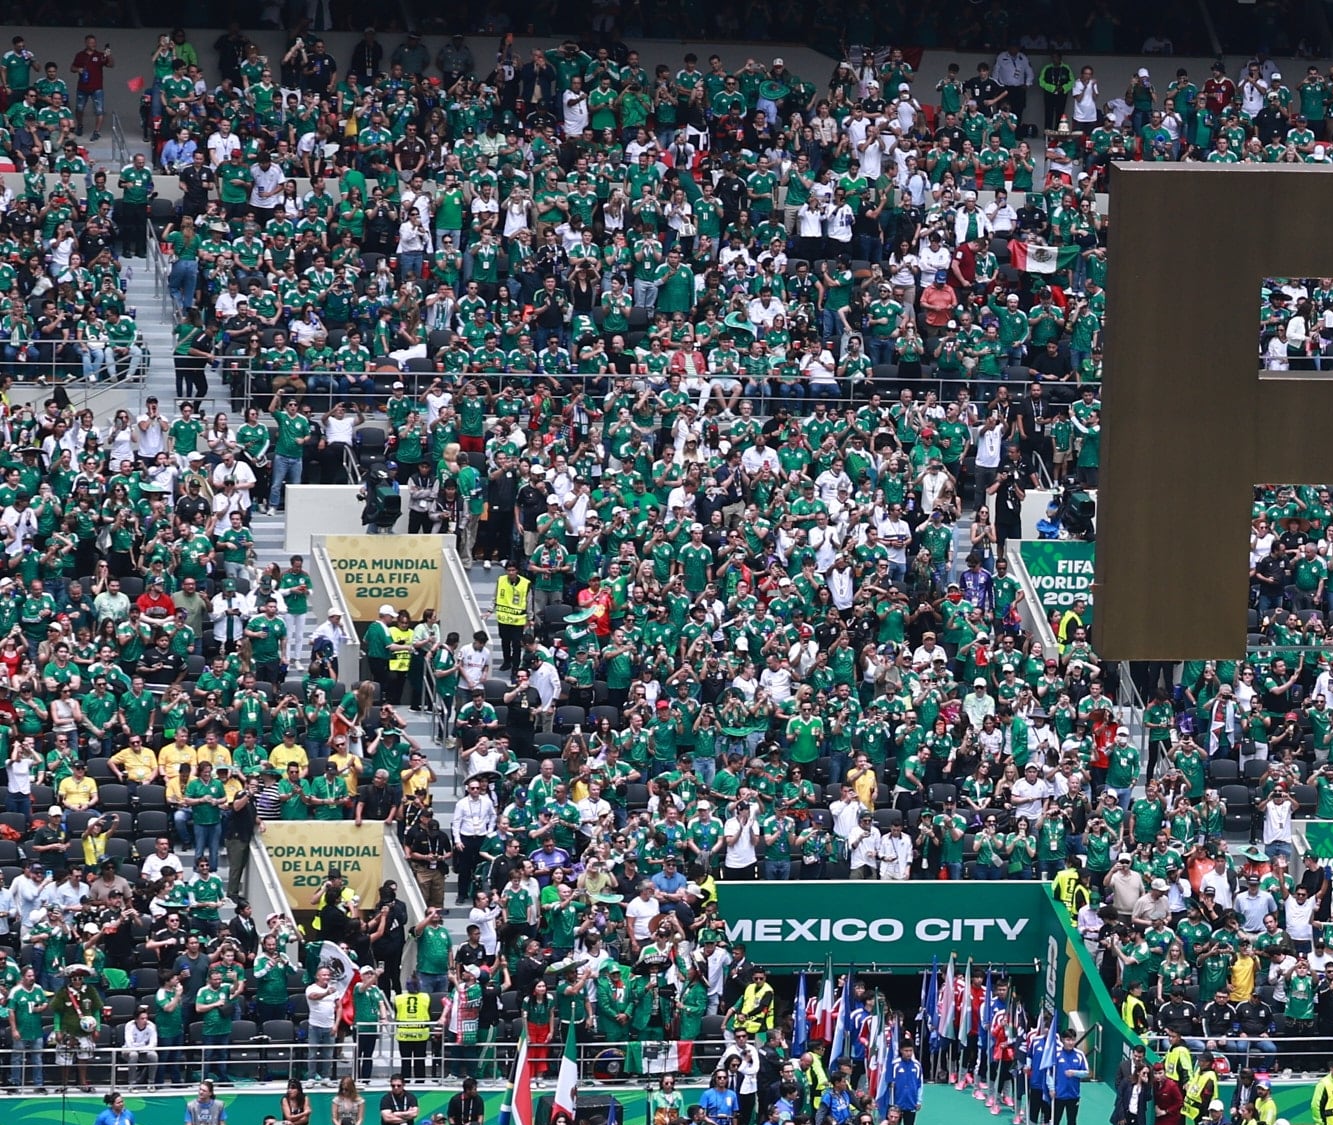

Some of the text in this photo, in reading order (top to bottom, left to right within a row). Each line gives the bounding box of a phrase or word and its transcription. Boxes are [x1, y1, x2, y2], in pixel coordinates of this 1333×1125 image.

[331, 558, 439, 571] COPA MUNDIAL
[1057, 559, 1094, 574] FIFA
[344, 573, 421, 584] DE LA FIFA
[355, 586, 409, 599] 2026
[265, 845, 381, 858] COPA MUNDIAL
[281, 860, 362, 873] DE LA FIFA
[292, 875, 349, 888] 206
[723, 917, 1030, 943] MEXICO CITY
